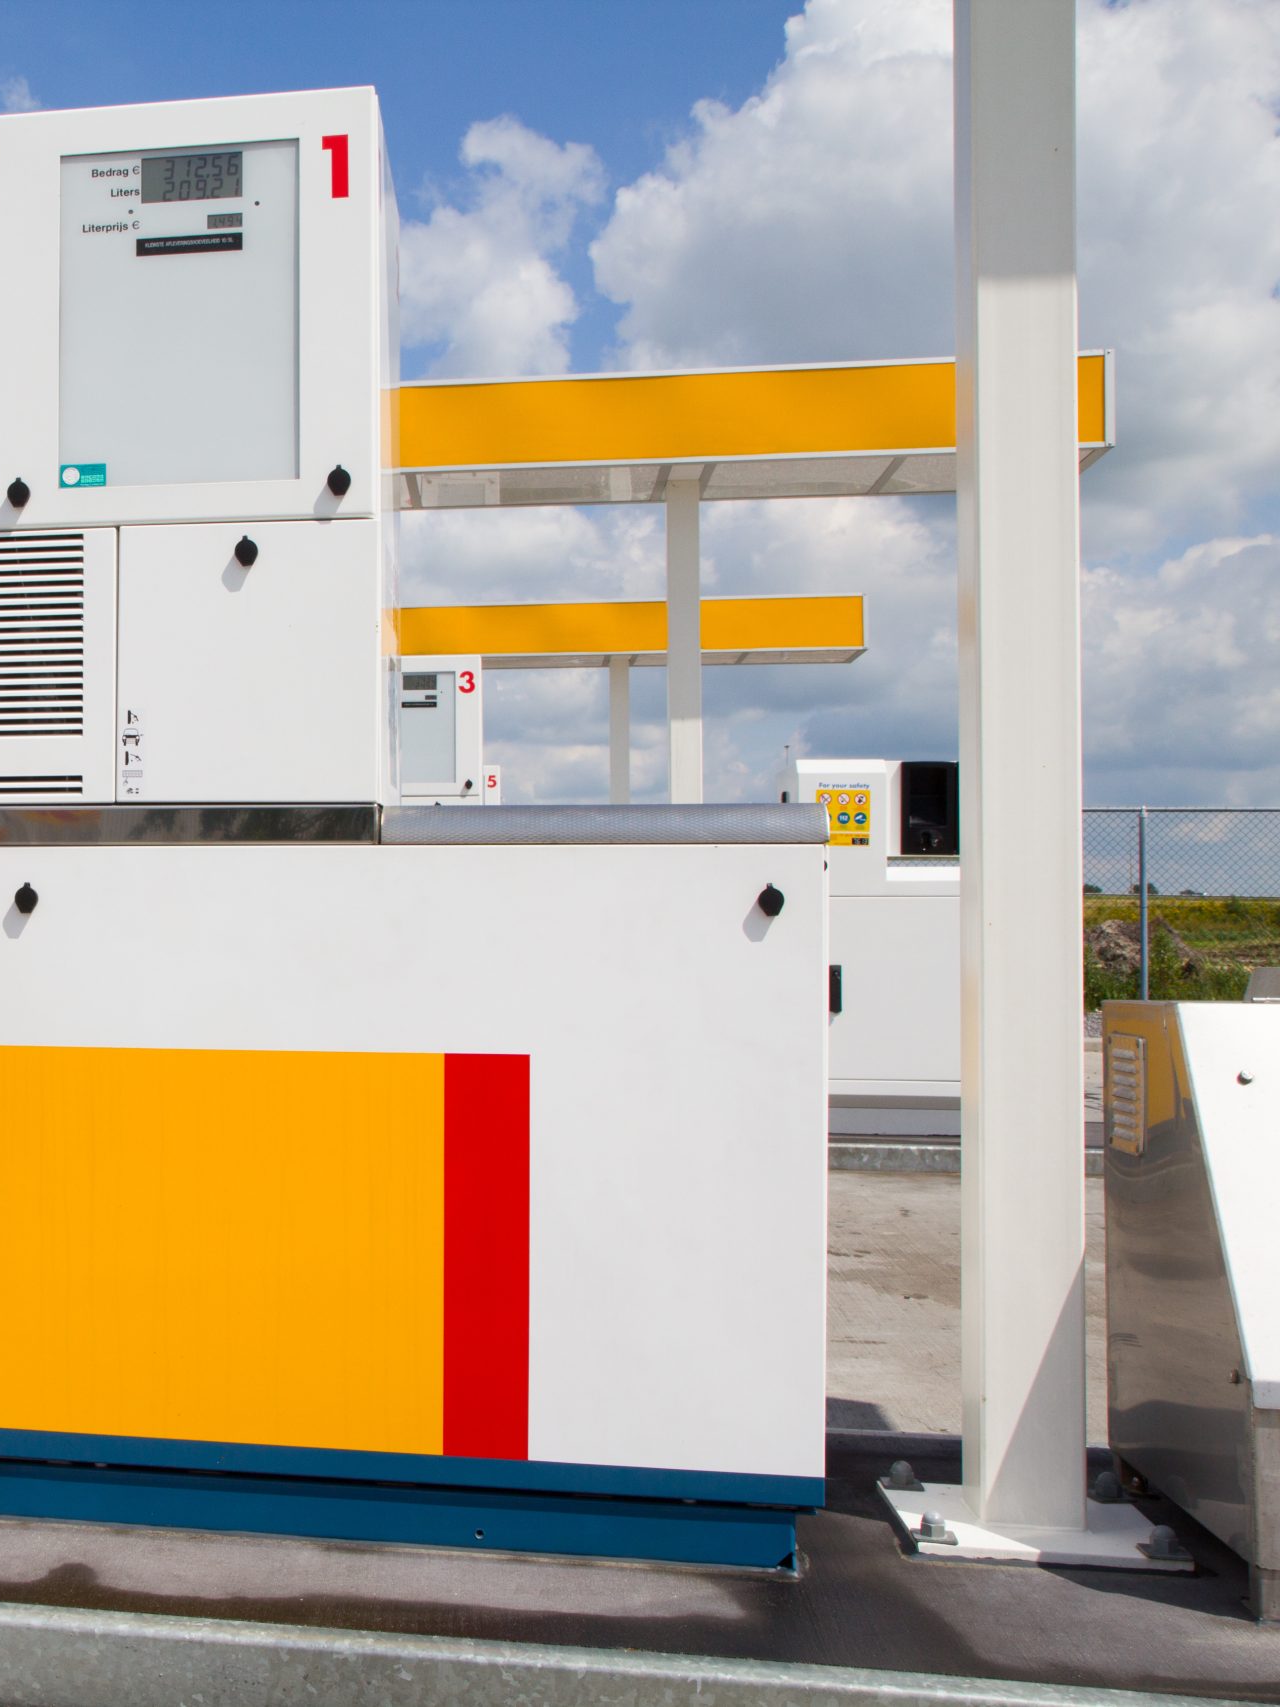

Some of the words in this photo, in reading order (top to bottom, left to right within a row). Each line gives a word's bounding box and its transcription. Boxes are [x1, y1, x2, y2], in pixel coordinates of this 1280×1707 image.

[91, 168, 129, 178] Bedrag
[132, 165, 140, 175] €
[322, 134, 349, 198] 1
[110, 188, 140, 198] Liters
[82, 221, 129, 233] Literprijs
[132, 220, 140, 230] €
[458, 670, 476, 694] 3
[487, 775, 497, 788] 5
